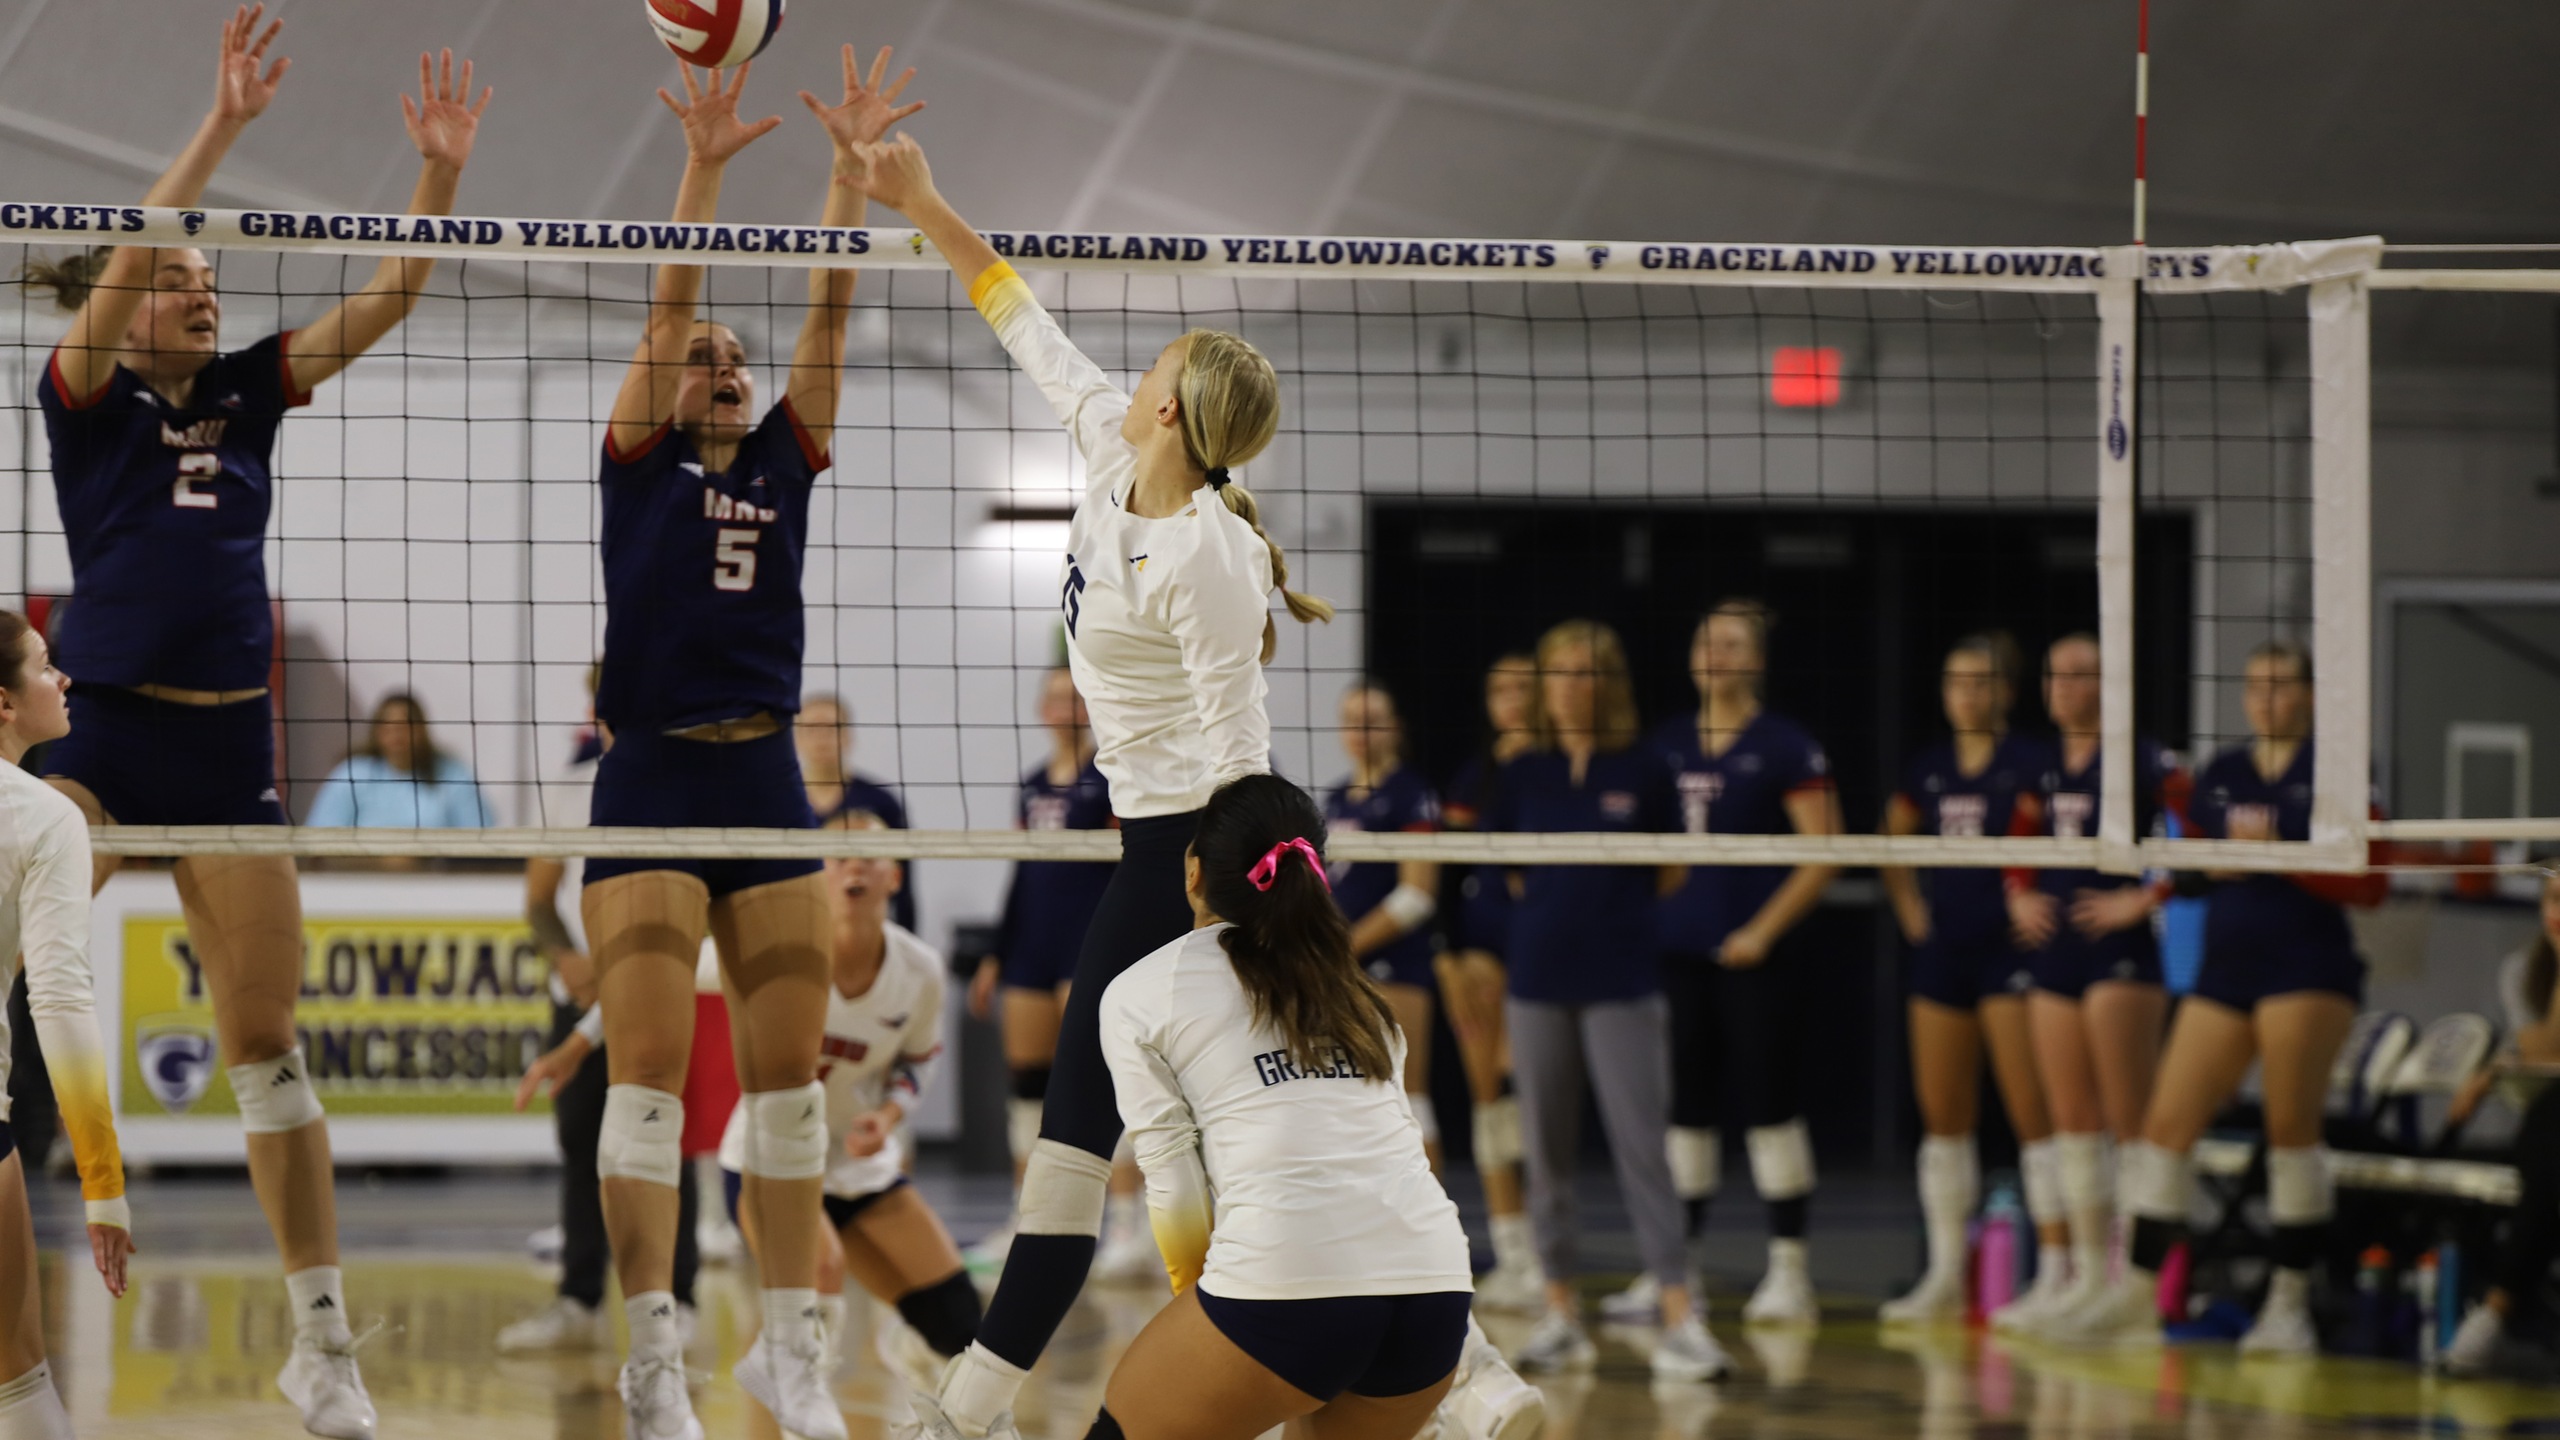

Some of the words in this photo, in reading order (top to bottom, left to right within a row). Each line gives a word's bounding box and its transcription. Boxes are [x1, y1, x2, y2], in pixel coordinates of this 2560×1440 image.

[239, 212, 502, 245] GRACELAND
[517, 222, 870, 254] YELLOWJACKETS
[978, 233, 1208, 261] RACELAND
[1222, 238, 1556, 267] YELLOWJACKETS
[1641, 246, 1876, 273] GRACELAND
[173, 452, 221, 509] 2
[714, 527, 760, 592] 5
